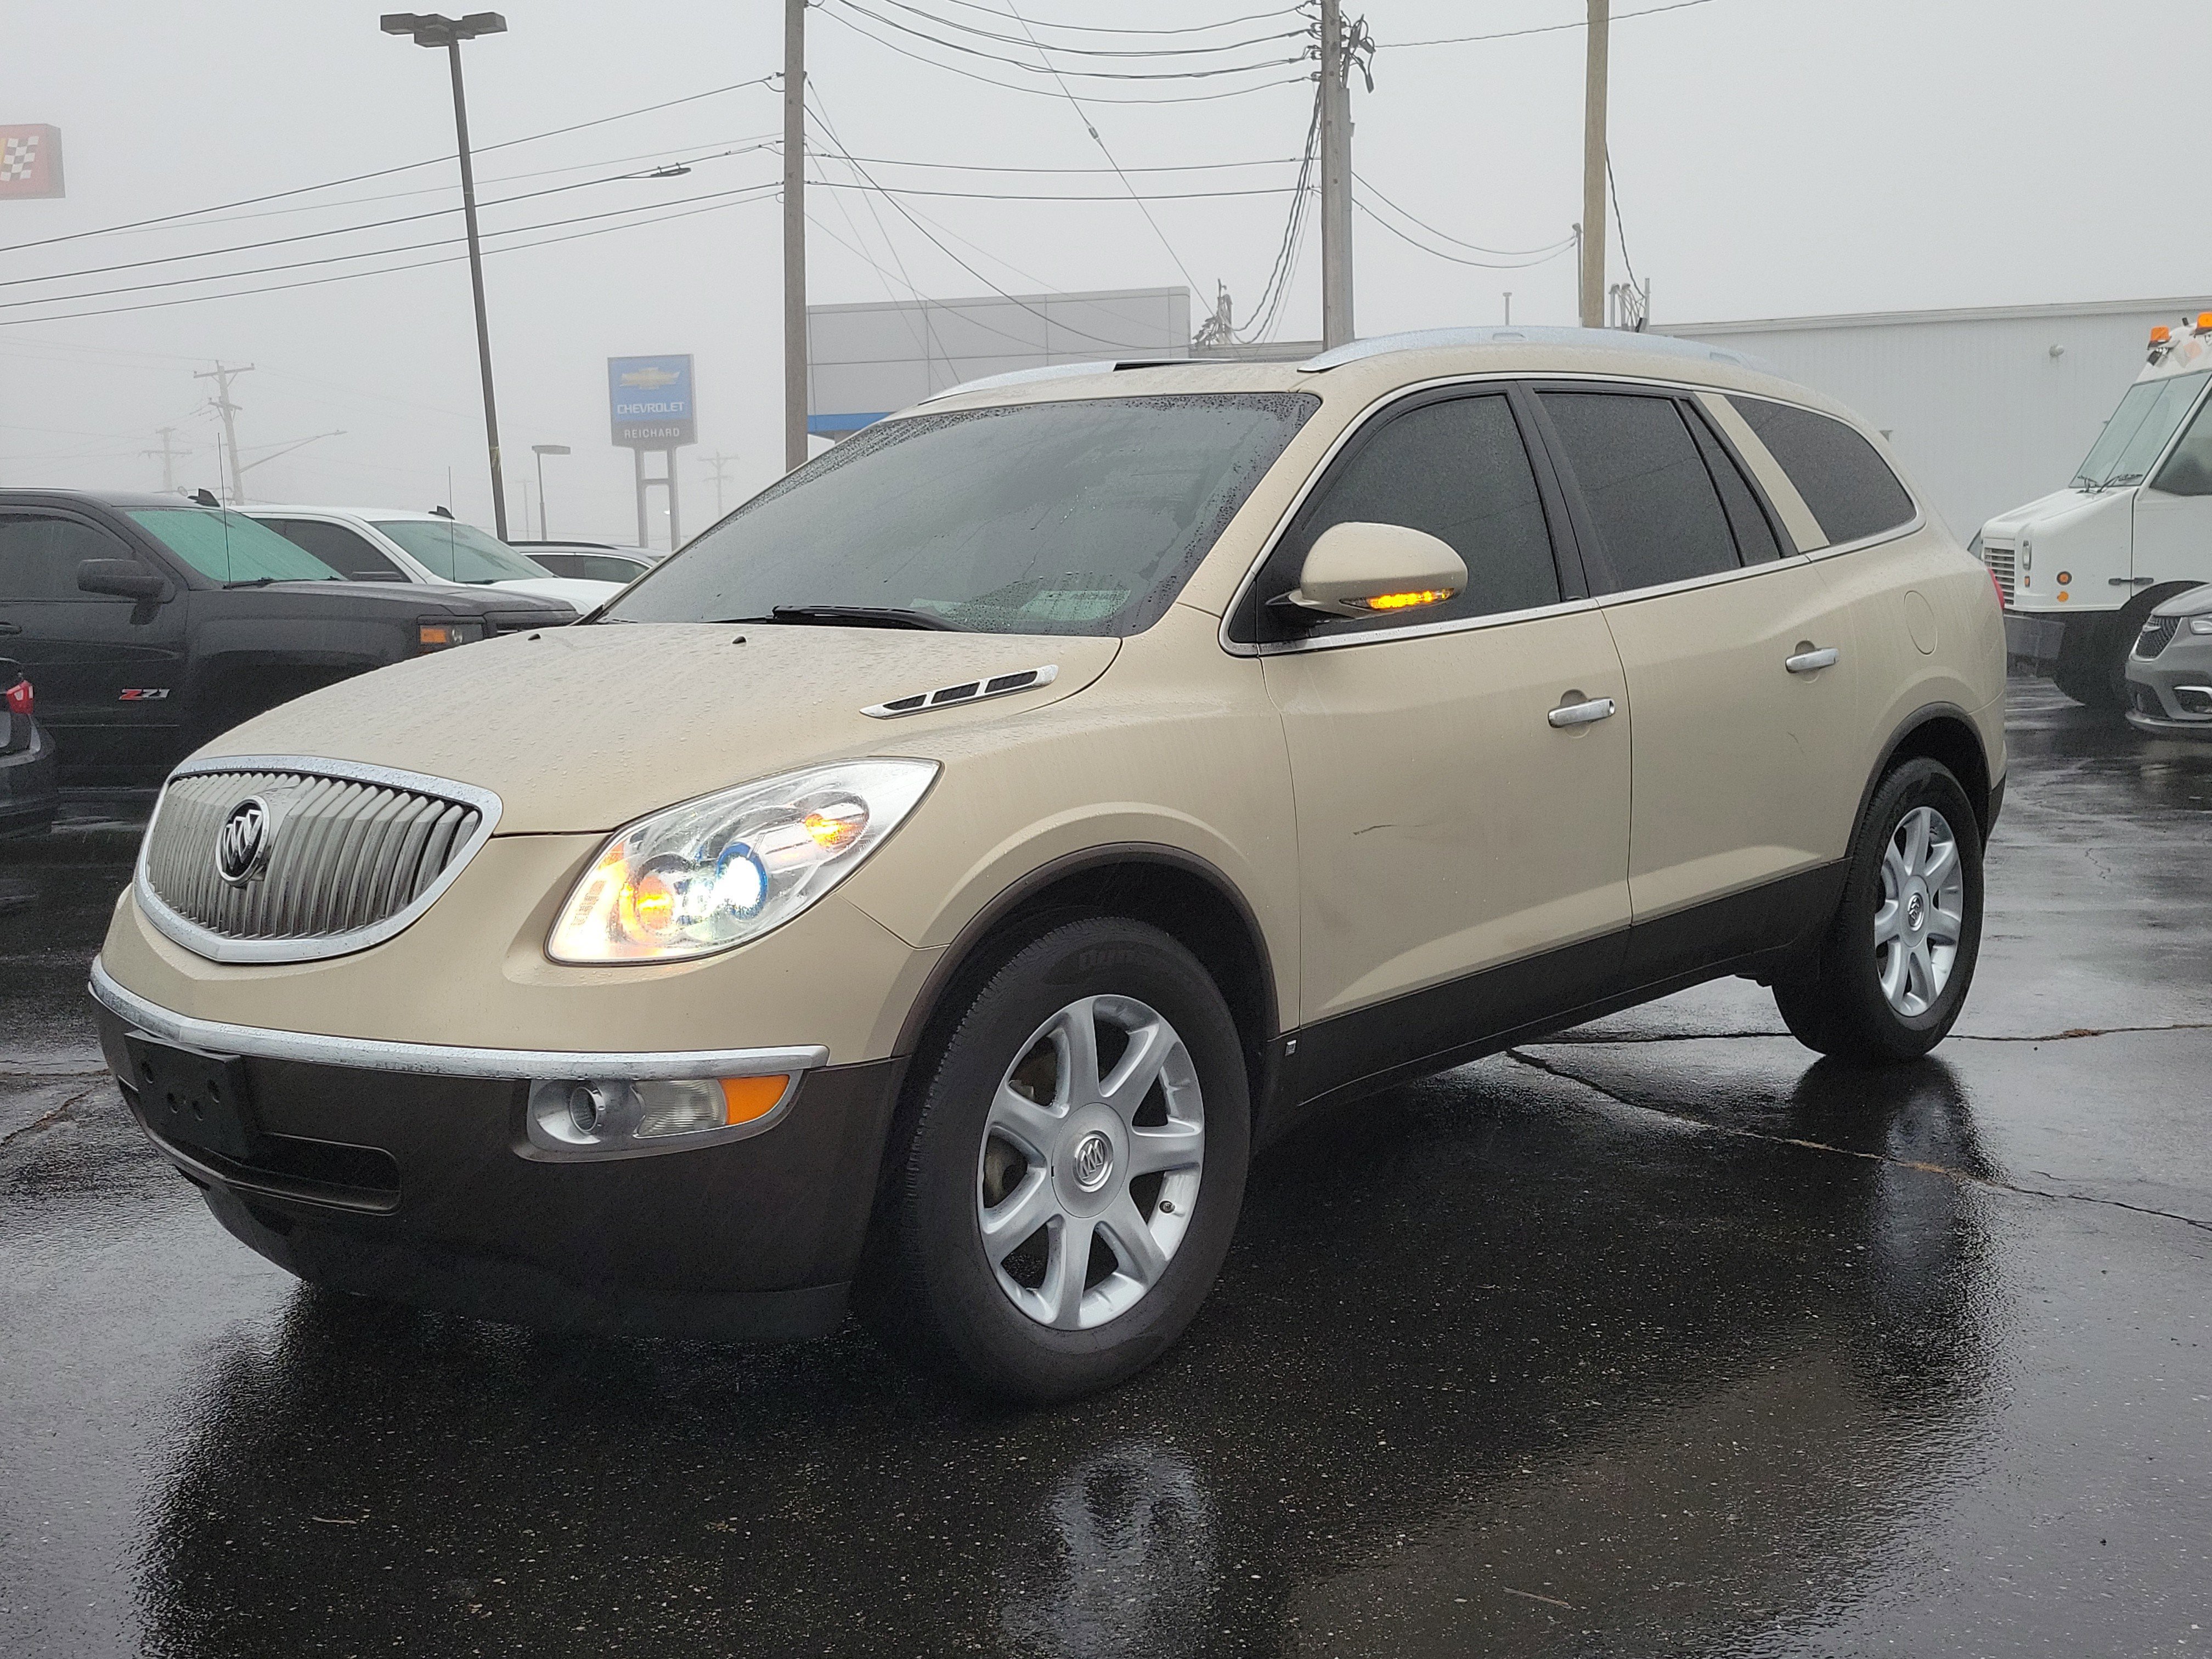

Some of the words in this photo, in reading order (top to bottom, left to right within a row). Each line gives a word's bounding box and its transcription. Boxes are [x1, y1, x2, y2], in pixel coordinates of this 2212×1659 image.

[617, 402, 684, 414] CHEVROLET
[624, 428, 680, 439] REICHARD
[119, 689, 170, 700] Z71
